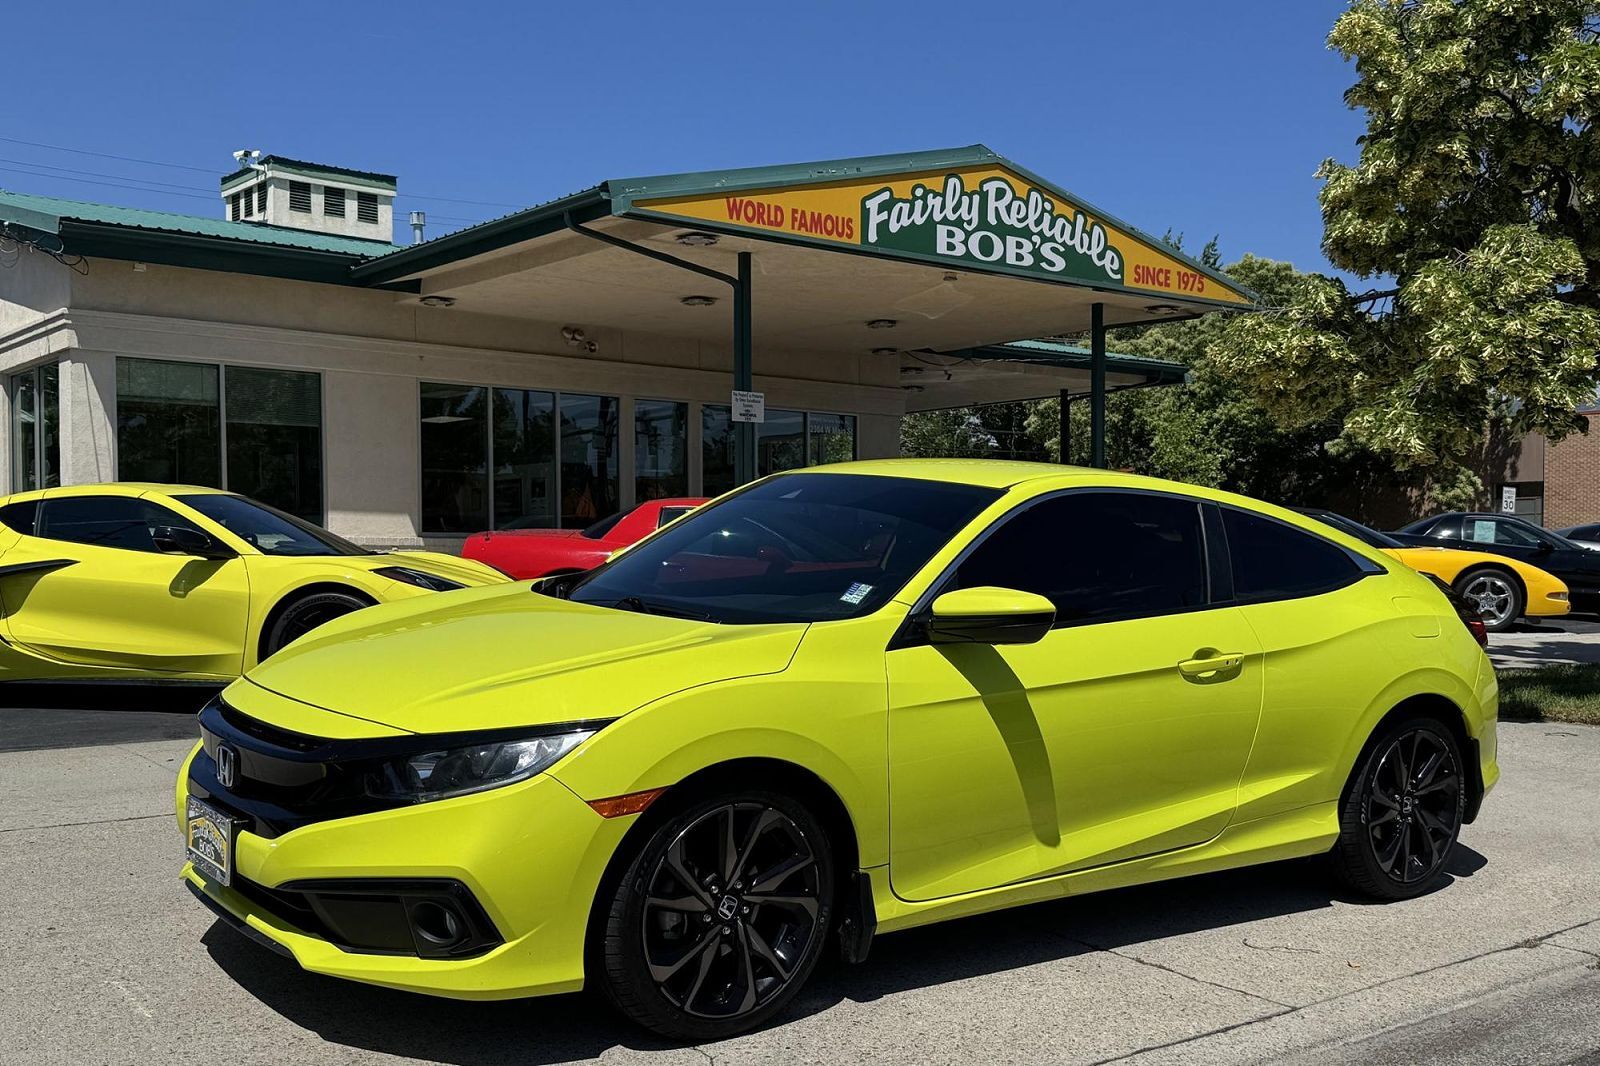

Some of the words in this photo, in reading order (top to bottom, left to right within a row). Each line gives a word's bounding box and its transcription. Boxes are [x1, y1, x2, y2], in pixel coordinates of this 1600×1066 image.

[725, 197, 785, 228] WORLD
[791, 208, 854, 240] FAMOUS
[866, 177, 980, 244] Fairly
[982, 180, 1122, 280] Reliable
[936, 224, 1067, 273] BOB'S
[1133, 263, 1171, 288] SINCE
[1176, 271, 1206, 293] 1975
[1503, 500, 1514, 510] 30
